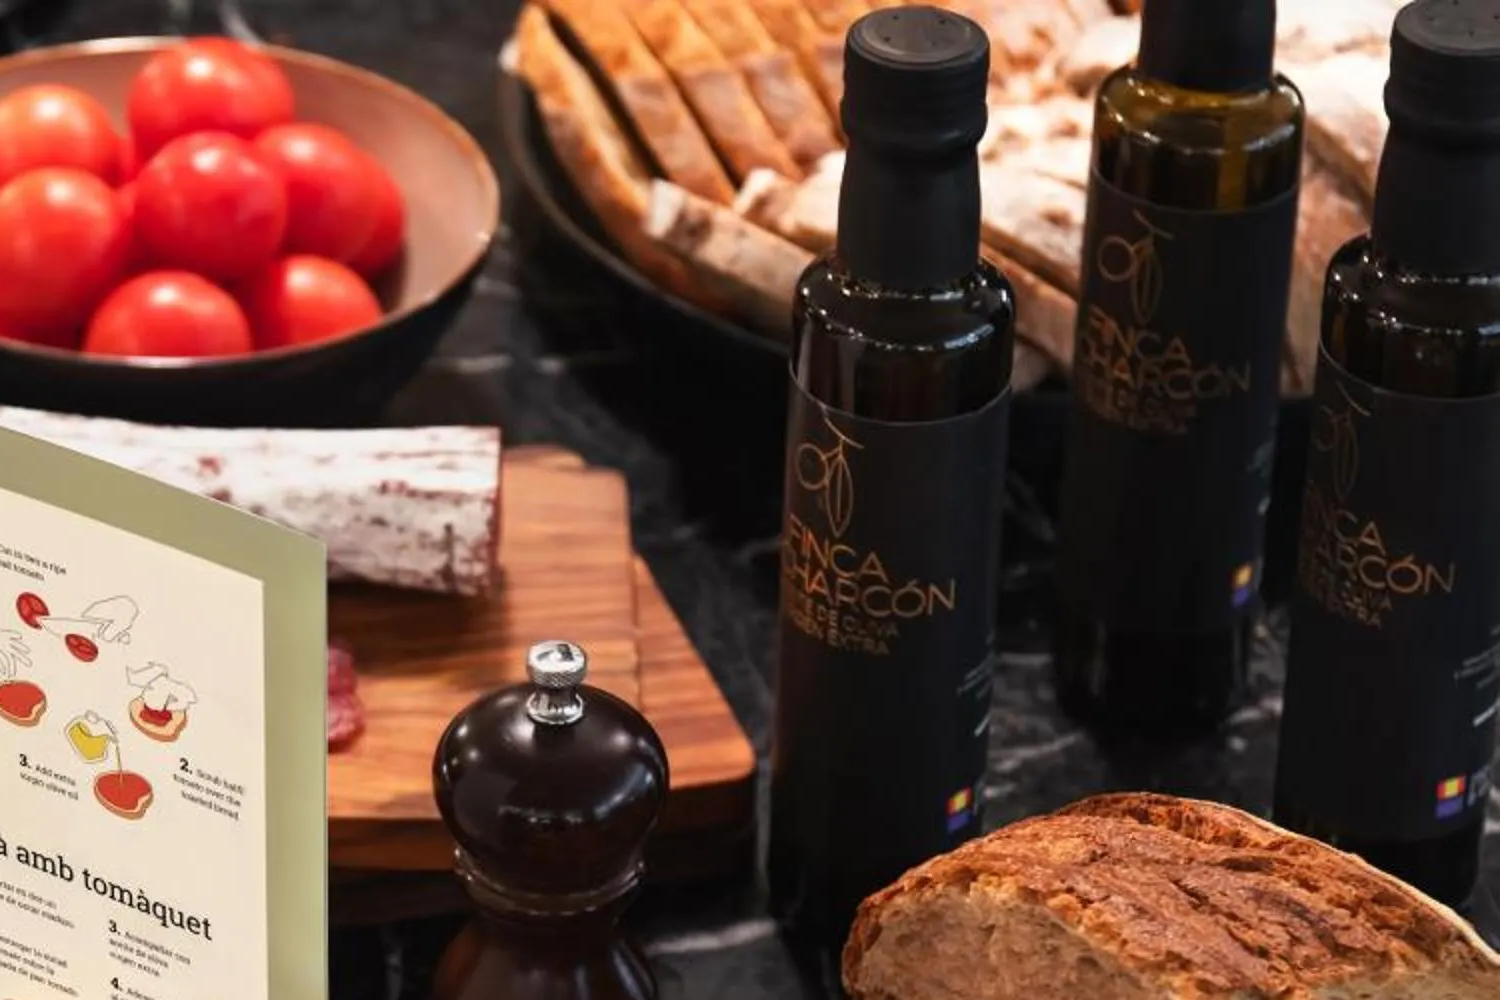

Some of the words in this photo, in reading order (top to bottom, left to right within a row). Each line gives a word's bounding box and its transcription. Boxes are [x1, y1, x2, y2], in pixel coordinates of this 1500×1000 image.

[19, 752, 33, 769] 3.
[179, 756, 193, 775] 2.
[15, 844, 75, 883] amb
[82, 867, 213, 941] tomàquet
[108, 919, 121, 936] 3.
[110, 977, 123, 992] 4.
